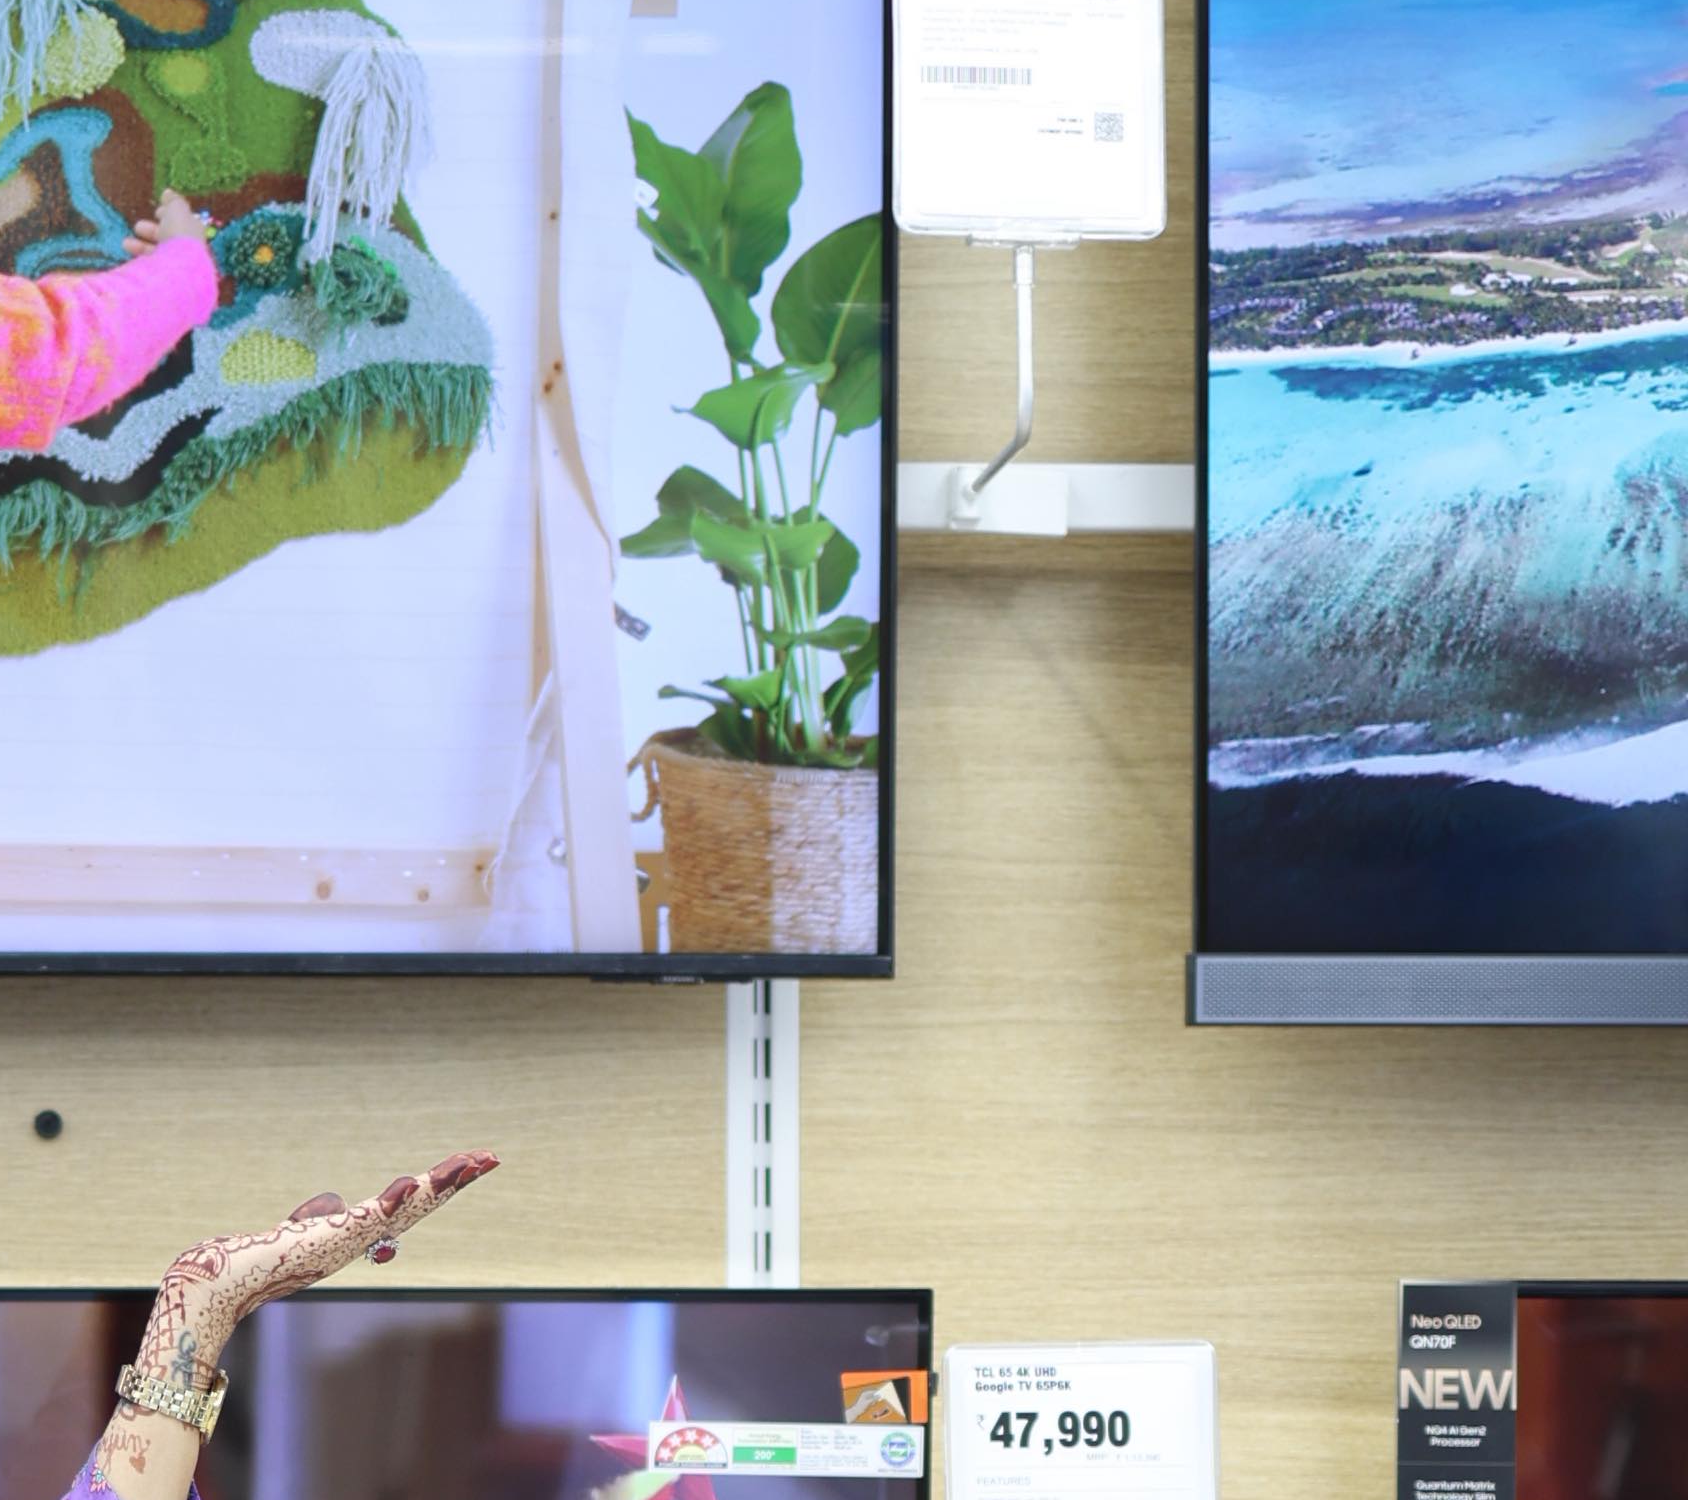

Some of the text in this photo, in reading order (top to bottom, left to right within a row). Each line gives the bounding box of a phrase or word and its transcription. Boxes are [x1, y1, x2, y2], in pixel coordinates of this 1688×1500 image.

[1411, 1314, 1482, 1330] Neo QLED
[975, 1368, 996, 1379] TCL
[1016, 1367, 1031, 1378] 4K
[1034, 1367, 1057, 1378] UHD
[975, 1381, 1014, 1393] Google
[1018, 1381, 1032, 1391] TV
[1399, 1368, 1514, 1411] NEW
